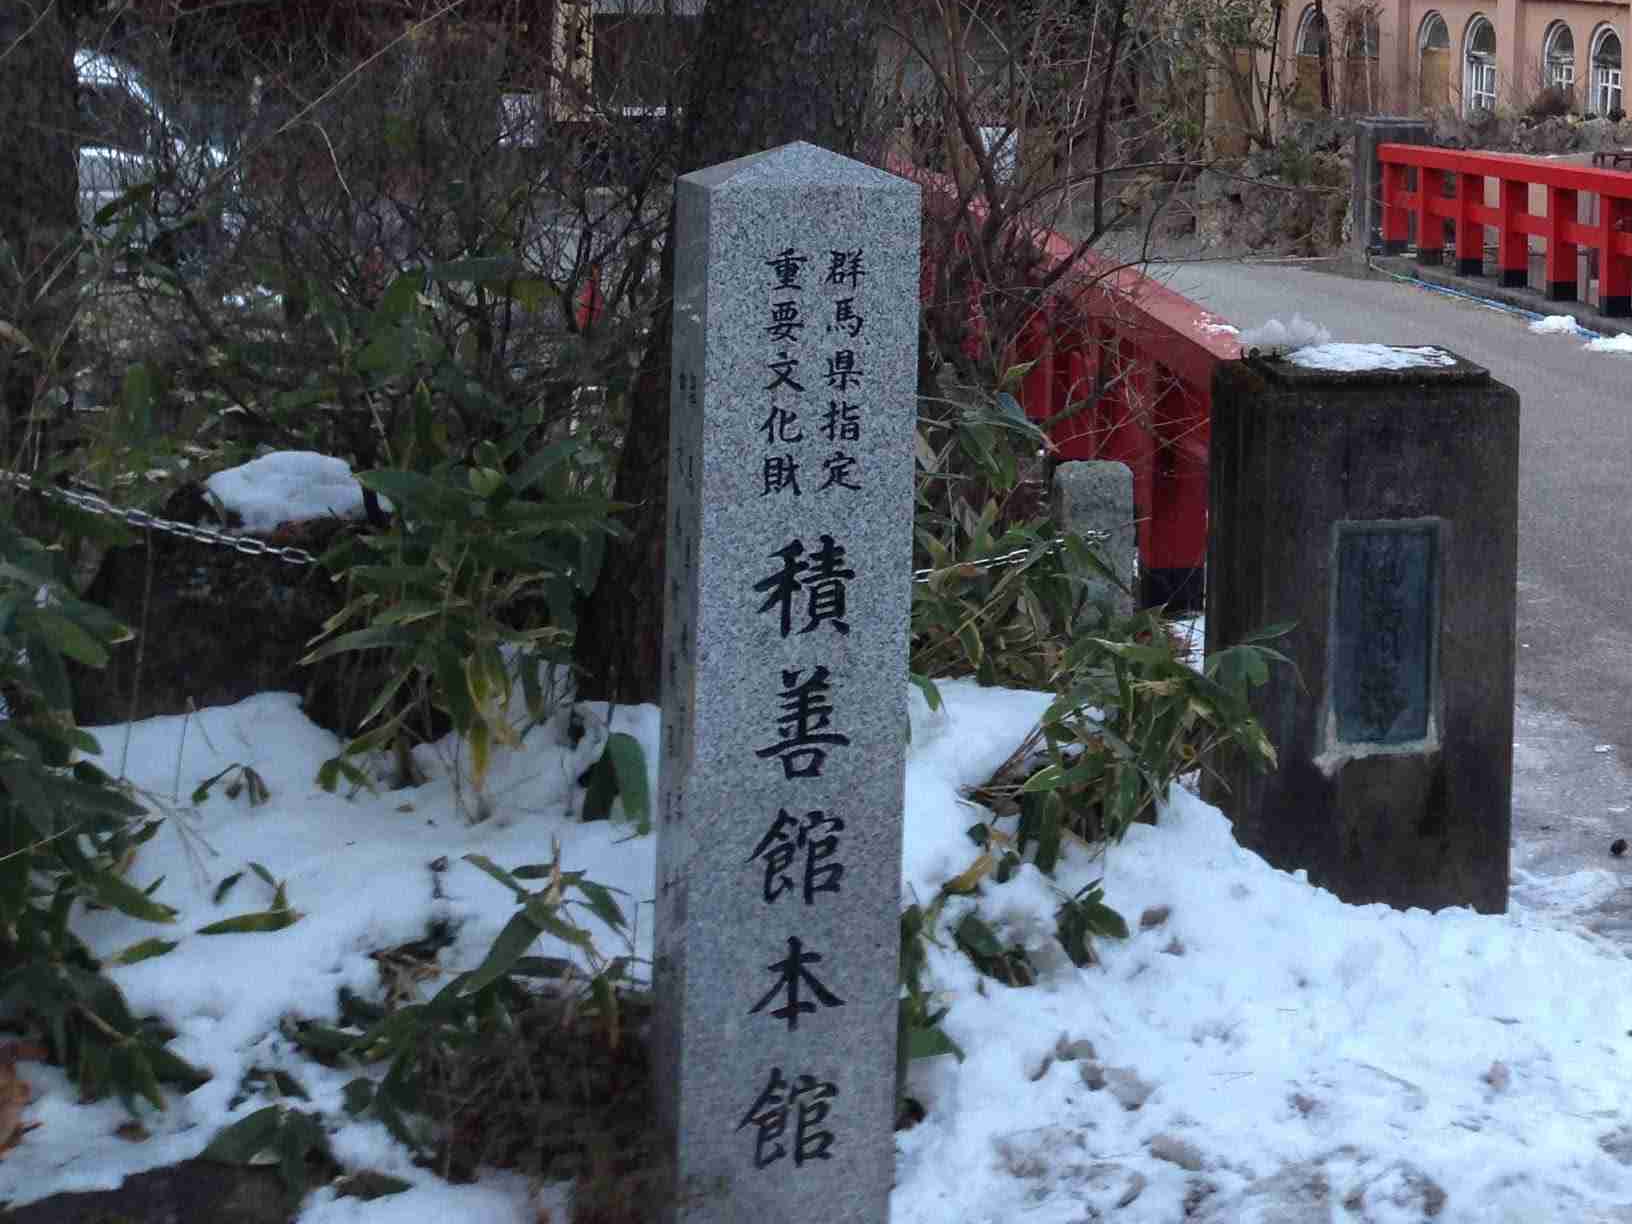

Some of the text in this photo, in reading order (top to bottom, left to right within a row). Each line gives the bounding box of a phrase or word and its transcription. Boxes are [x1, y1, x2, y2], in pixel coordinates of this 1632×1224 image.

[760, 248, 808, 498] 重要文化財
[820, 248, 867, 492] 群馬県指定
[735, 534, 856, 1169] 積善館本館
